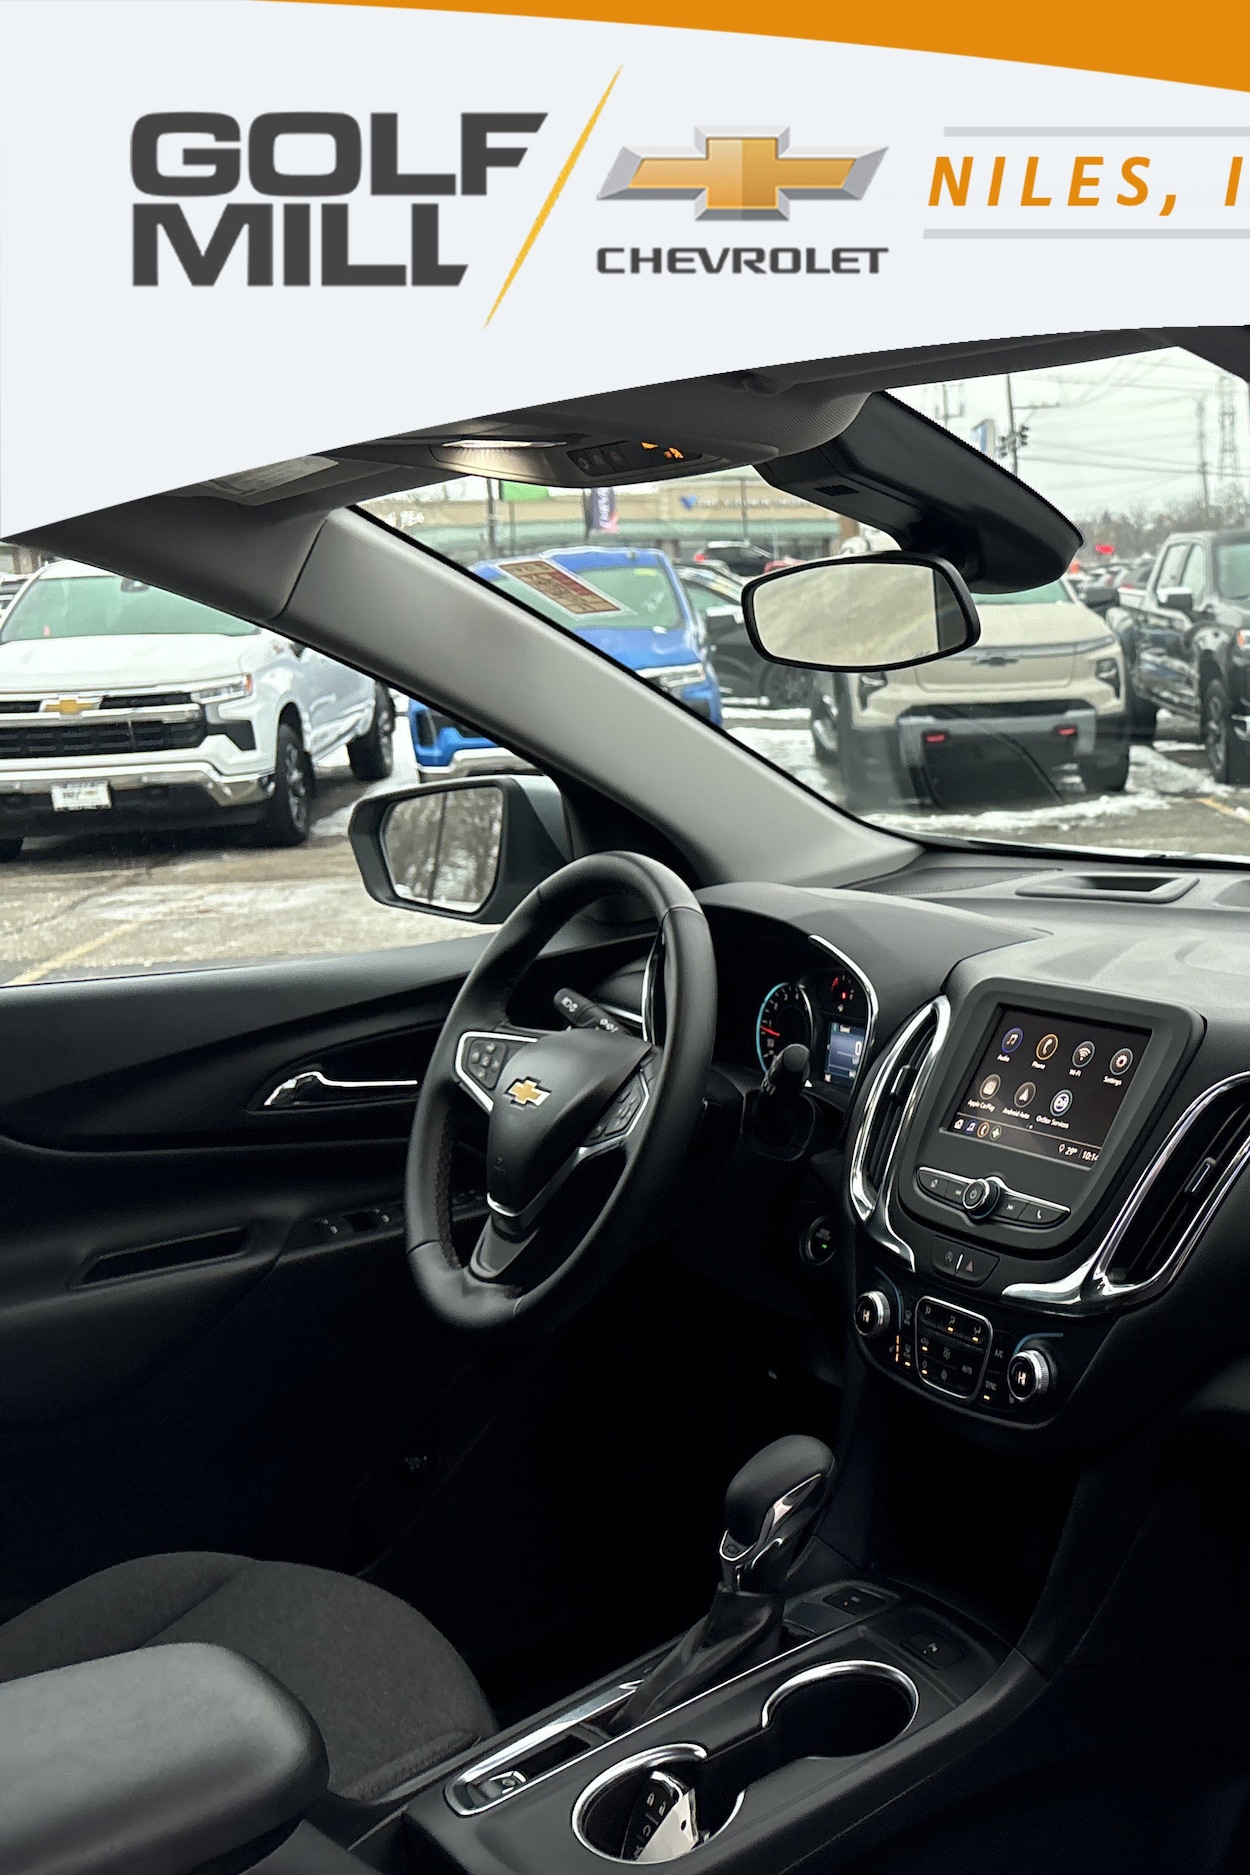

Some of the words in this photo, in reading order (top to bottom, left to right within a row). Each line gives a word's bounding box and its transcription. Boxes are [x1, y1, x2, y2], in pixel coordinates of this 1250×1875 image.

[997, 1054, 1010, 1063] Audio
[1031, 1061, 1046, 1070] Phone
[1103, 1076, 1122, 1086] Settings
[967, 1099, 981, 1108] Apple
[980, 1102, 996, 1112] CarPlay
[1002, 1108, 1019, 1118] Android
[1019, 1111, 1030, 1120] Auto
[1036, 1115, 1052, 1126] OnStar
[1052, 1118, 1070, 1129] Services
